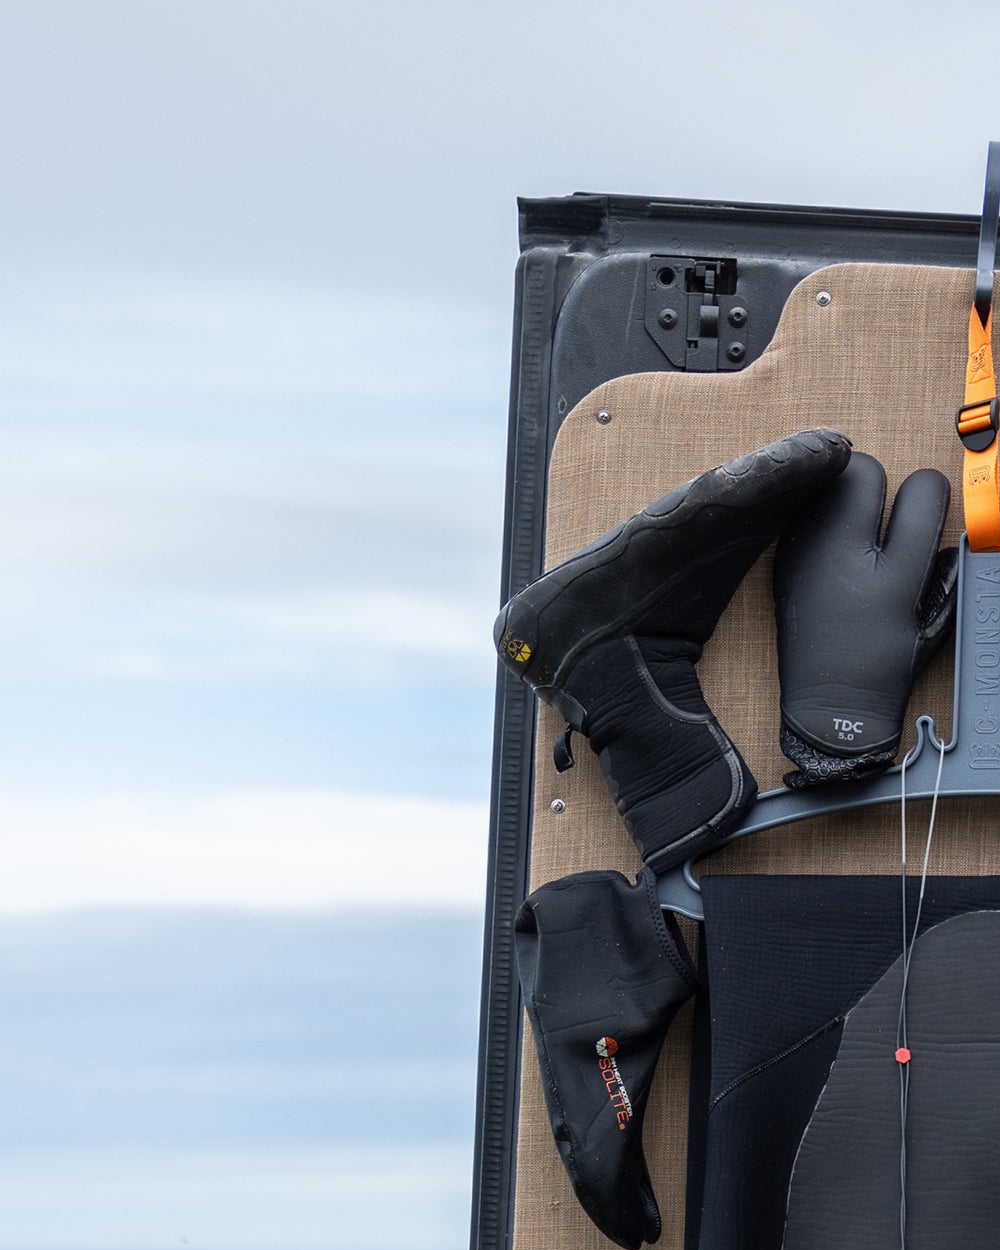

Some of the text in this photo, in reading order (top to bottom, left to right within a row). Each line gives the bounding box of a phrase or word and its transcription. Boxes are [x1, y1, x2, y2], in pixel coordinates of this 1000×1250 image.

[974, 567, 1000, 735] C-MONSTA
[832, 718, 864, 734] TDC
[838, 732, 854, 741] 5.0
[599, 1057, 630, 1123] SOLITE
